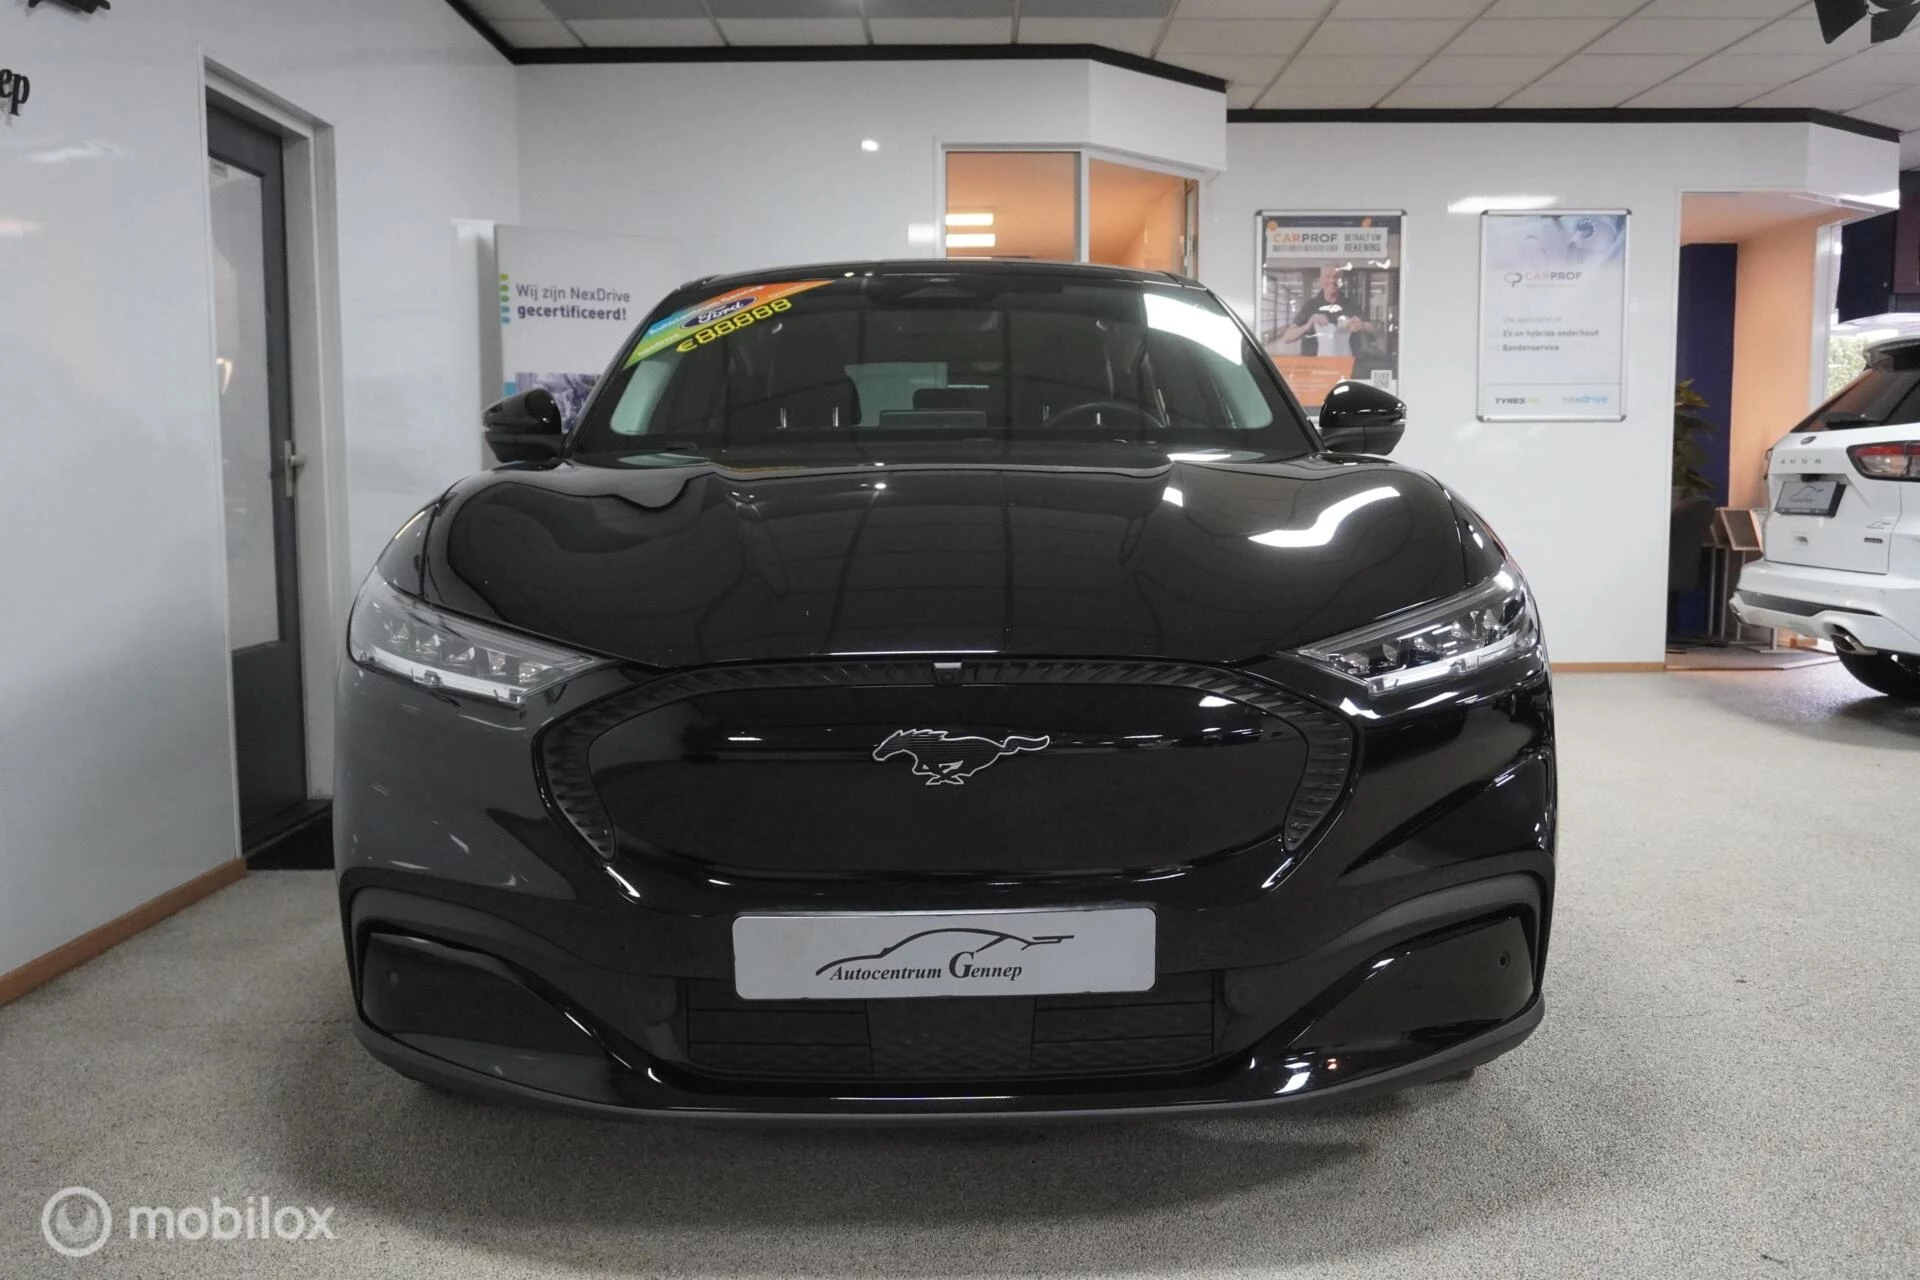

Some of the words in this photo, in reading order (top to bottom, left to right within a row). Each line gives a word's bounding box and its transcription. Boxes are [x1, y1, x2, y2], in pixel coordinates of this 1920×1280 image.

[1273, 233, 1338, 243] CARPROF
[1525, 271, 1583, 281] CARPROF
[516, 284, 538, 301] Wij
[542, 286, 566, 302] zijn
[570, 287, 630, 303] NexDrive
[518, 304, 627, 321] gecertificeerd!
[698, 301, 744, 324] Ford
[1557, 329, 1599, 338] onderhoud
[1502, 343, 1560, 352] Bandenservice
[829, 966, 942, 981] Autocentrum
[949, 951, 1022, 981] Gennep
